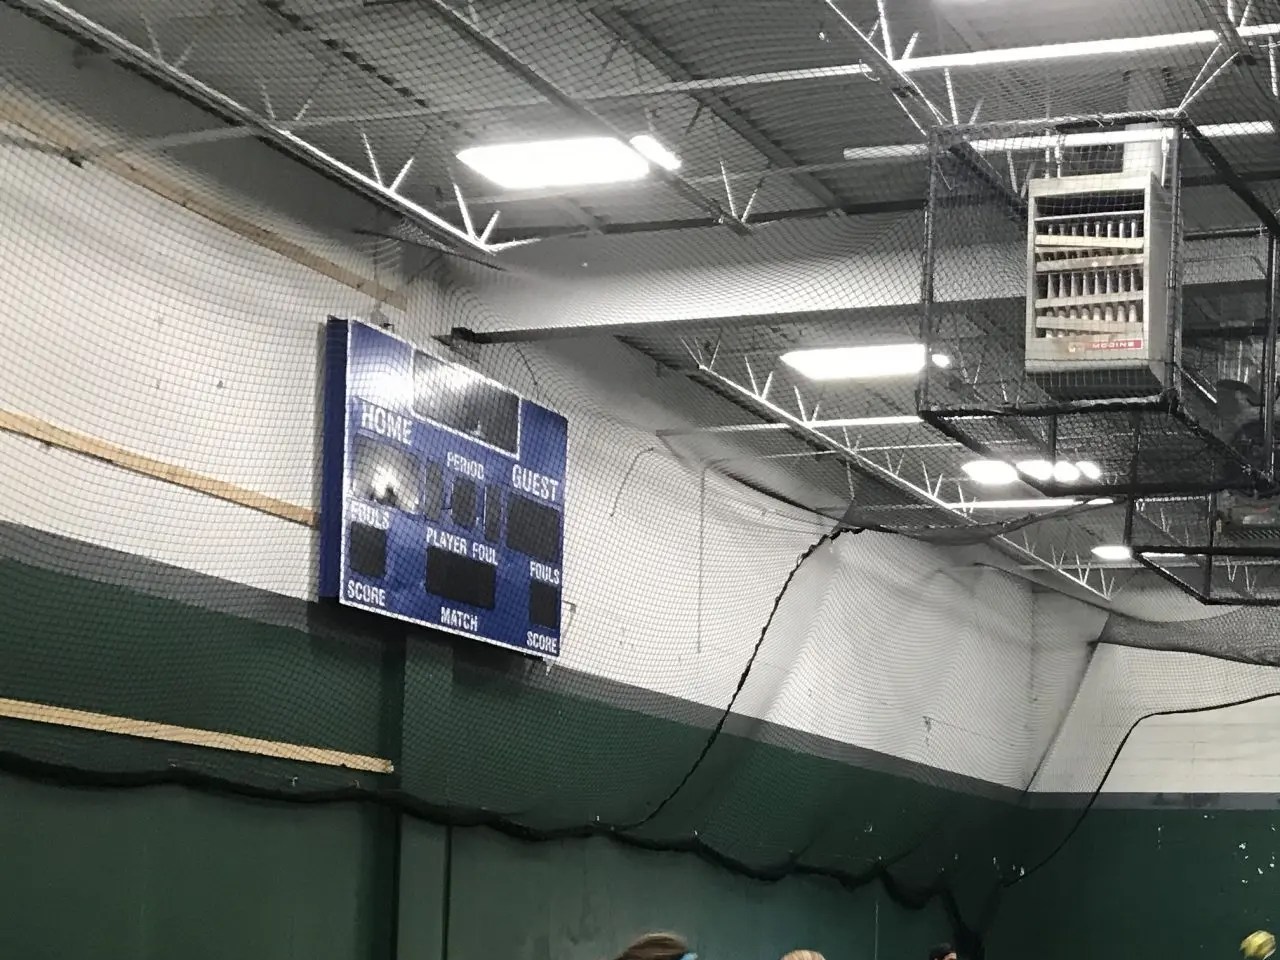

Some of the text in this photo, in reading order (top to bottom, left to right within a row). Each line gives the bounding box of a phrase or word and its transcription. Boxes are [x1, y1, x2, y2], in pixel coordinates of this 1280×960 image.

[361, 406, 413, 445] HOME
[447, 451, 485, 480] PERIOD
[512, 465, 560, 501] GUEST
[351, 504, 389, 529] FOULS
[426, 527, 498, 566] PLAYER FOUL
[530, 561, 560, 584] FOULS
[347, 580, 386, 607] SCORE
[441, 607, 478, 632] MATCH
[526, 631, 557, 651] SCORE
